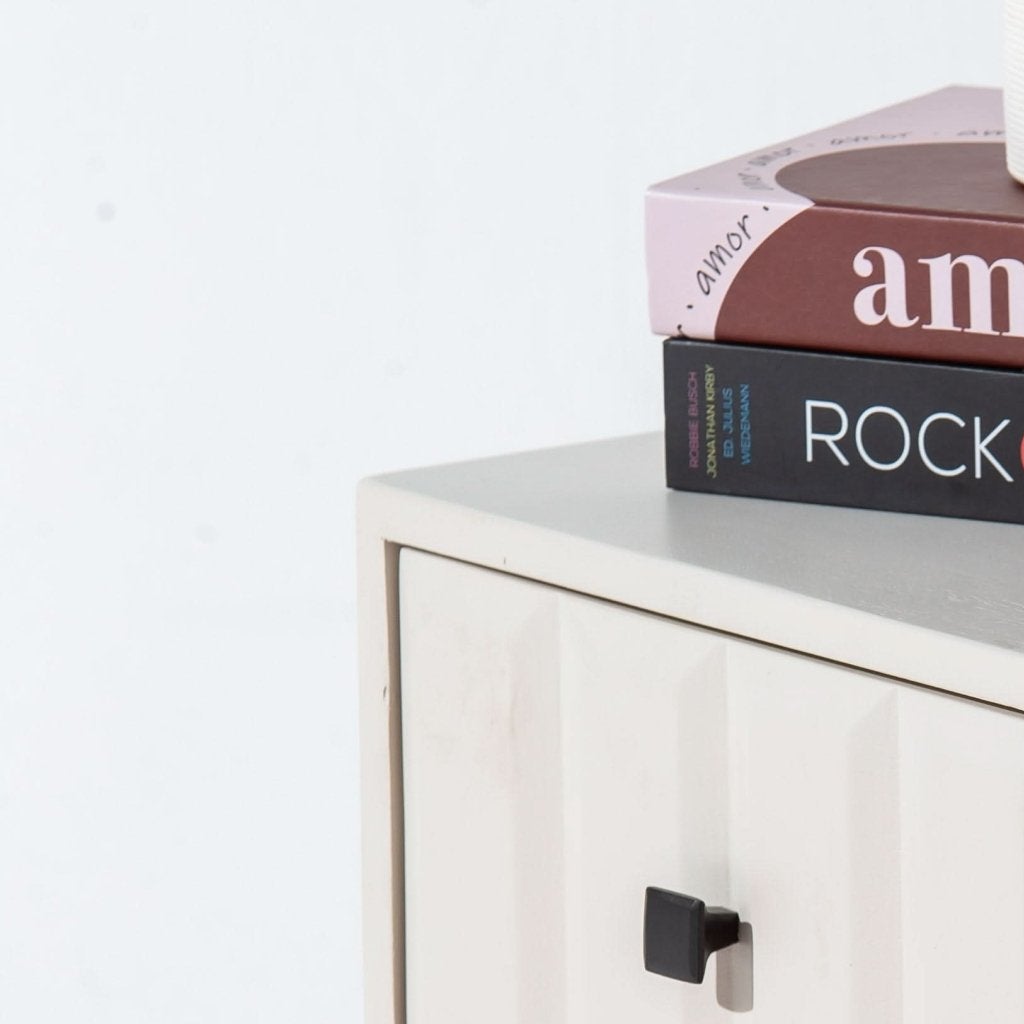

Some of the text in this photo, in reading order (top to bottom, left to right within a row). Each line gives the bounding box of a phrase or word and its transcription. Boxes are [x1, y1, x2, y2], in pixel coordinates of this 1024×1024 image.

[696, 213, 751, 296] amor
[688, 370, 699, 469] ROBBIE BUSCH
[705, 364, 717, 479] JONATHAN KIRBY
[722, 388, 733, 434] JULIUS
